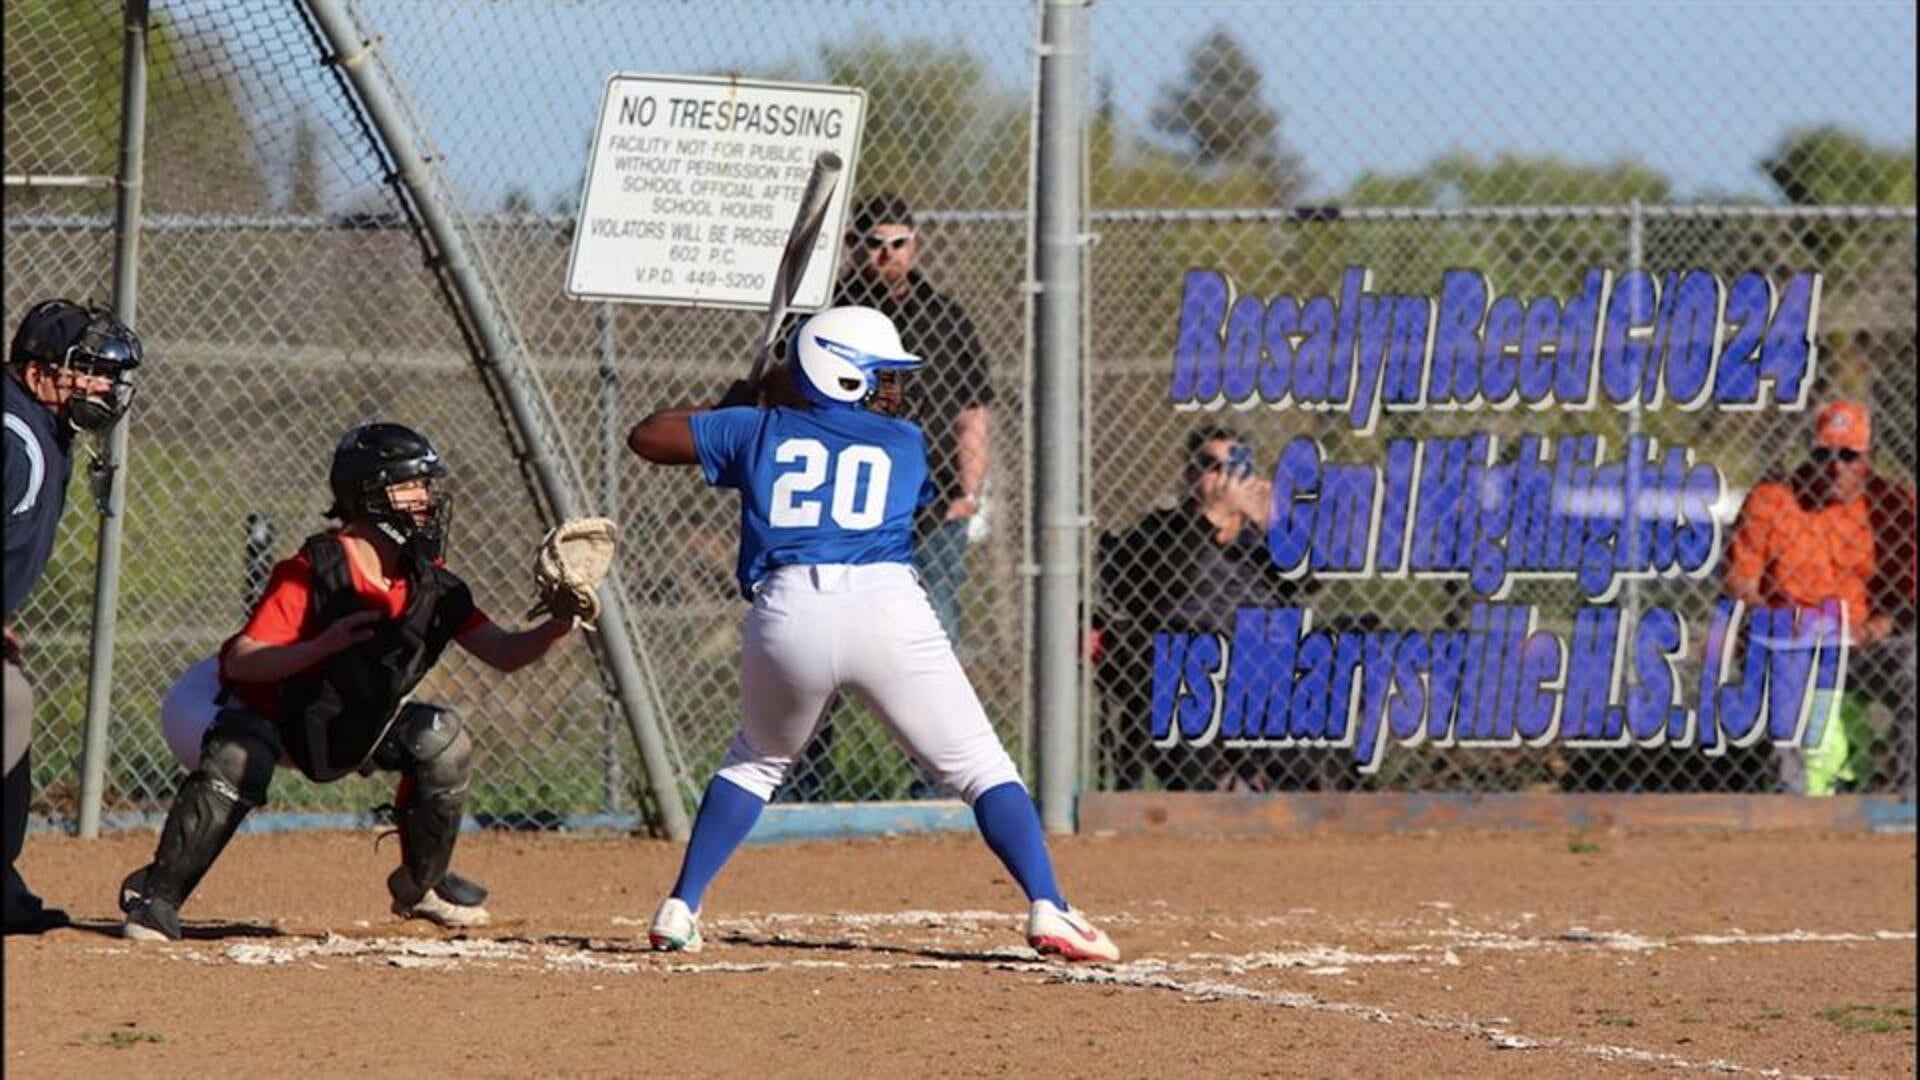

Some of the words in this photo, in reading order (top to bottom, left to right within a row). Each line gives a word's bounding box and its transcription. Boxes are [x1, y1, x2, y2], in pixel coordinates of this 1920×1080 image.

[619, 96, 657, 127] NO
[668, 98, 844, 138] TRESPASSING
[609, 135, 671, 153] FACILITY
[676, 139, 708, 155] NOT
[712, 140, 744, 159] FOR
[749, 143, 802, 162] PUBLIC
[614, 157, 681, 174] WITHOUT
[686, 159, 780, 179] PERMISSION
[623, 176, 684, 194] SCHOOL
[690, 179, 755, 199] OFFICIAL
[762, 185, 804, 202] AFTE
[652, 196, 712, 217] SCHOOL
[721, 201, 774, 220] HOURS
[591, 217, 665, 240] VIOLATORS
[672, 222, 702, 242] WILL
[708, 224, 728, 243] BE
[669, 245, 701, 262] 602
[684, 269, 767, 291] 449-5200
[769, 438, 892, 531] 20
